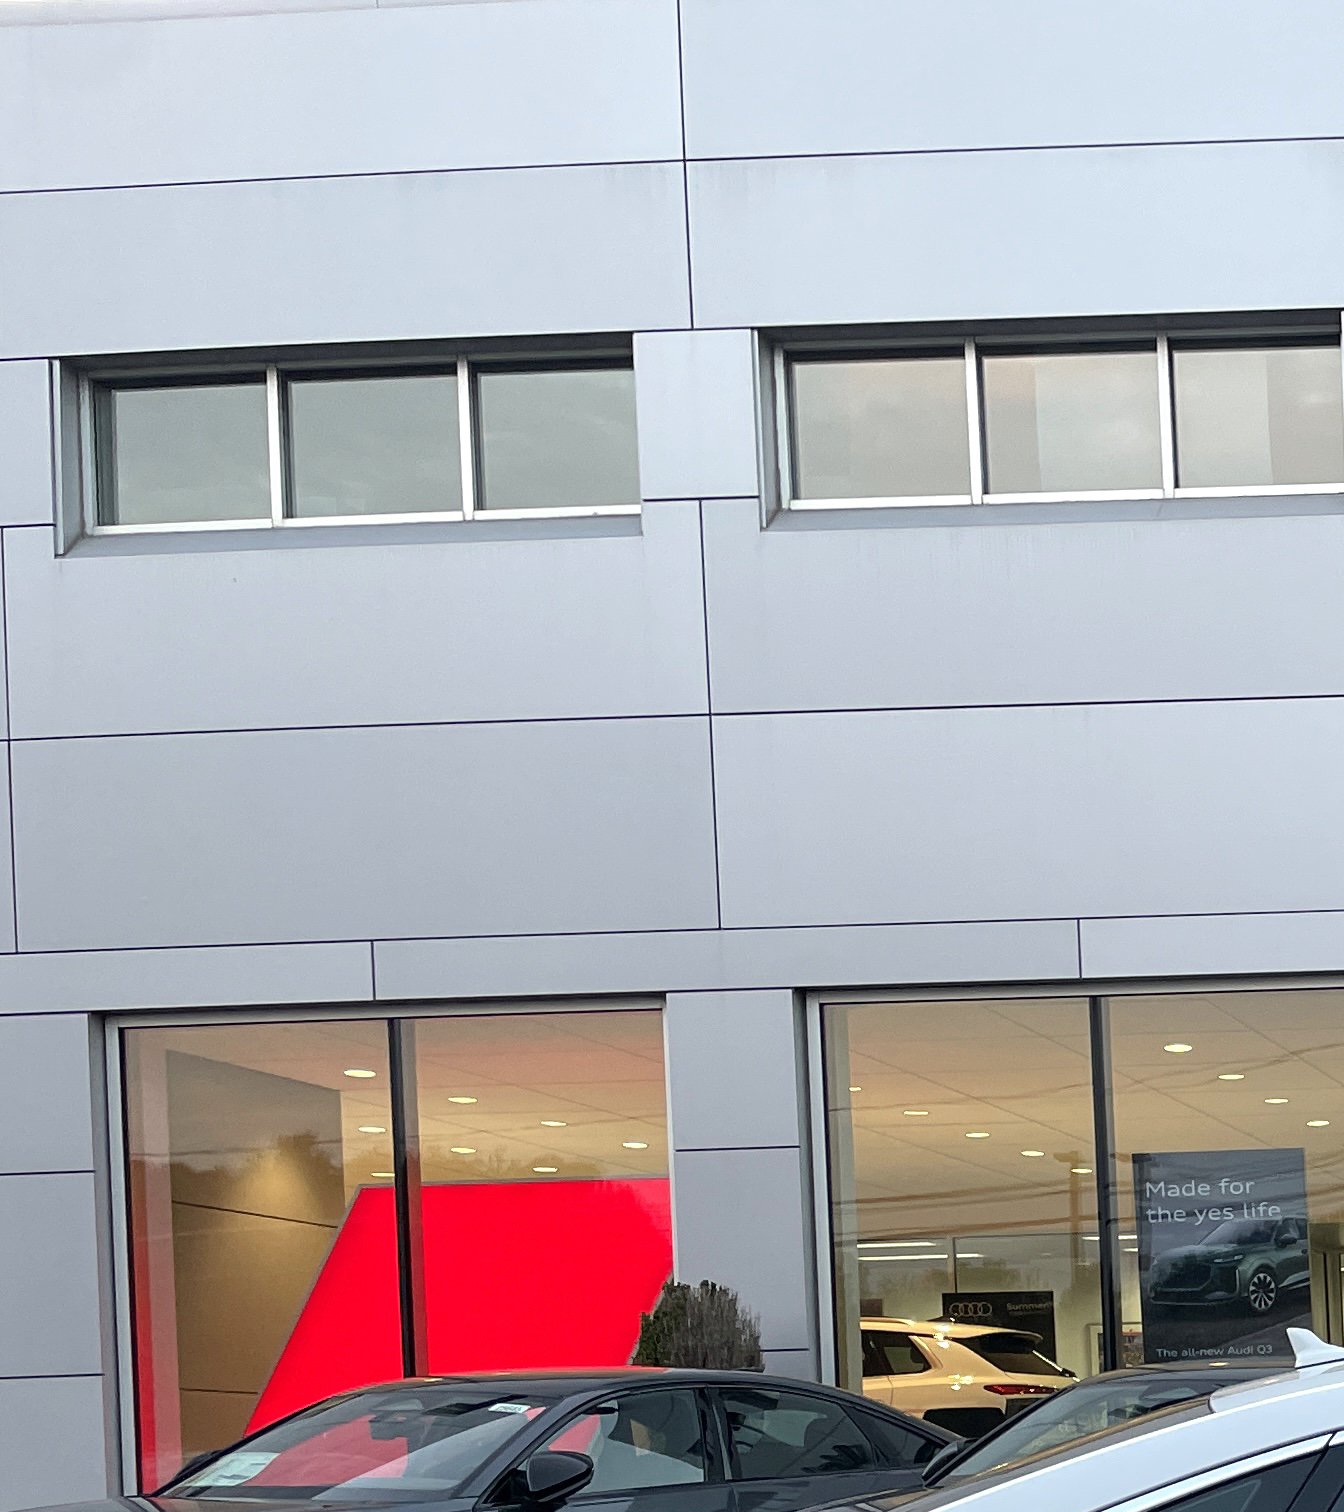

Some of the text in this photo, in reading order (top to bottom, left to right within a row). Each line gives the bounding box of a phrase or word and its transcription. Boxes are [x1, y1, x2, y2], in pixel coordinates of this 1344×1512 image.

[1145, 1178, 1255, 1198] Made for
[1146, 1201, 1281, 1226] the yes life
[1156, 1344, 1273, 1358] The all-new Audi Q3
